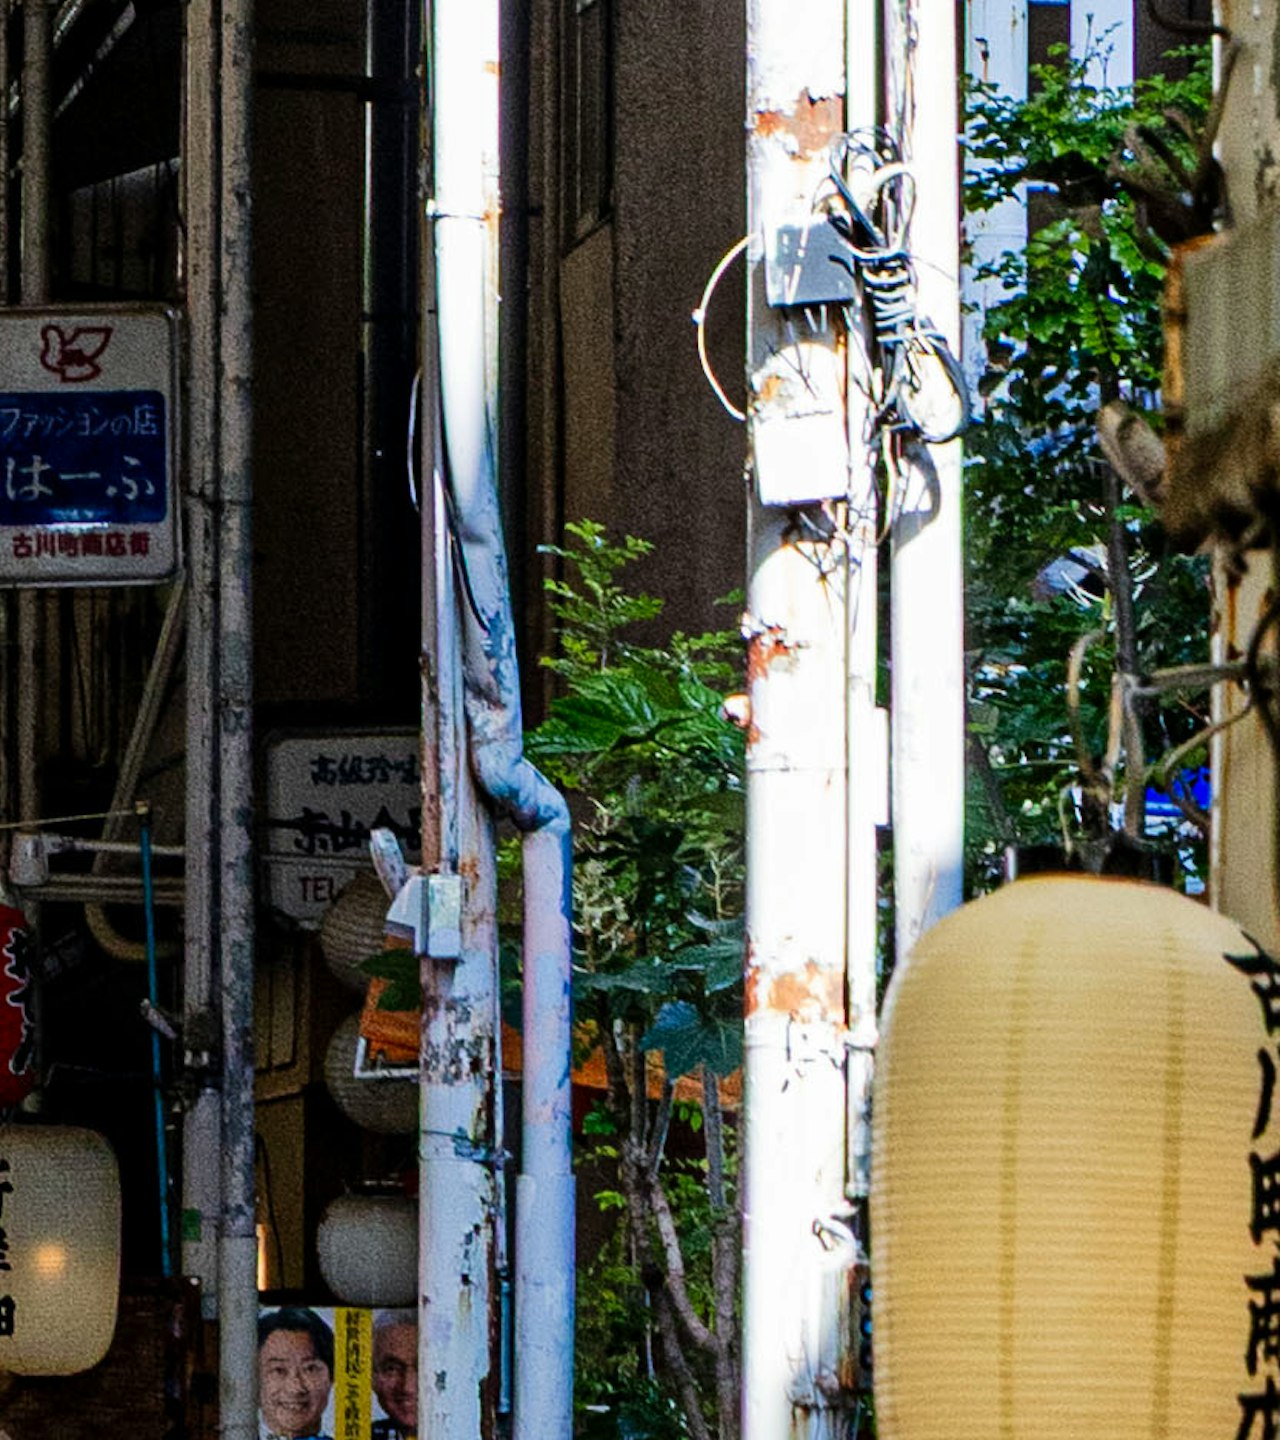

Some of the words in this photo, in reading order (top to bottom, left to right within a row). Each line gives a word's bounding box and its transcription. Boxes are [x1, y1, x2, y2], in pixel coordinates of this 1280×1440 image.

[0, 404, 160, 438] ファッションの店
[4, 454, 157, 502] はーふ
[12, 532, 151, 558] 古川町商店街
